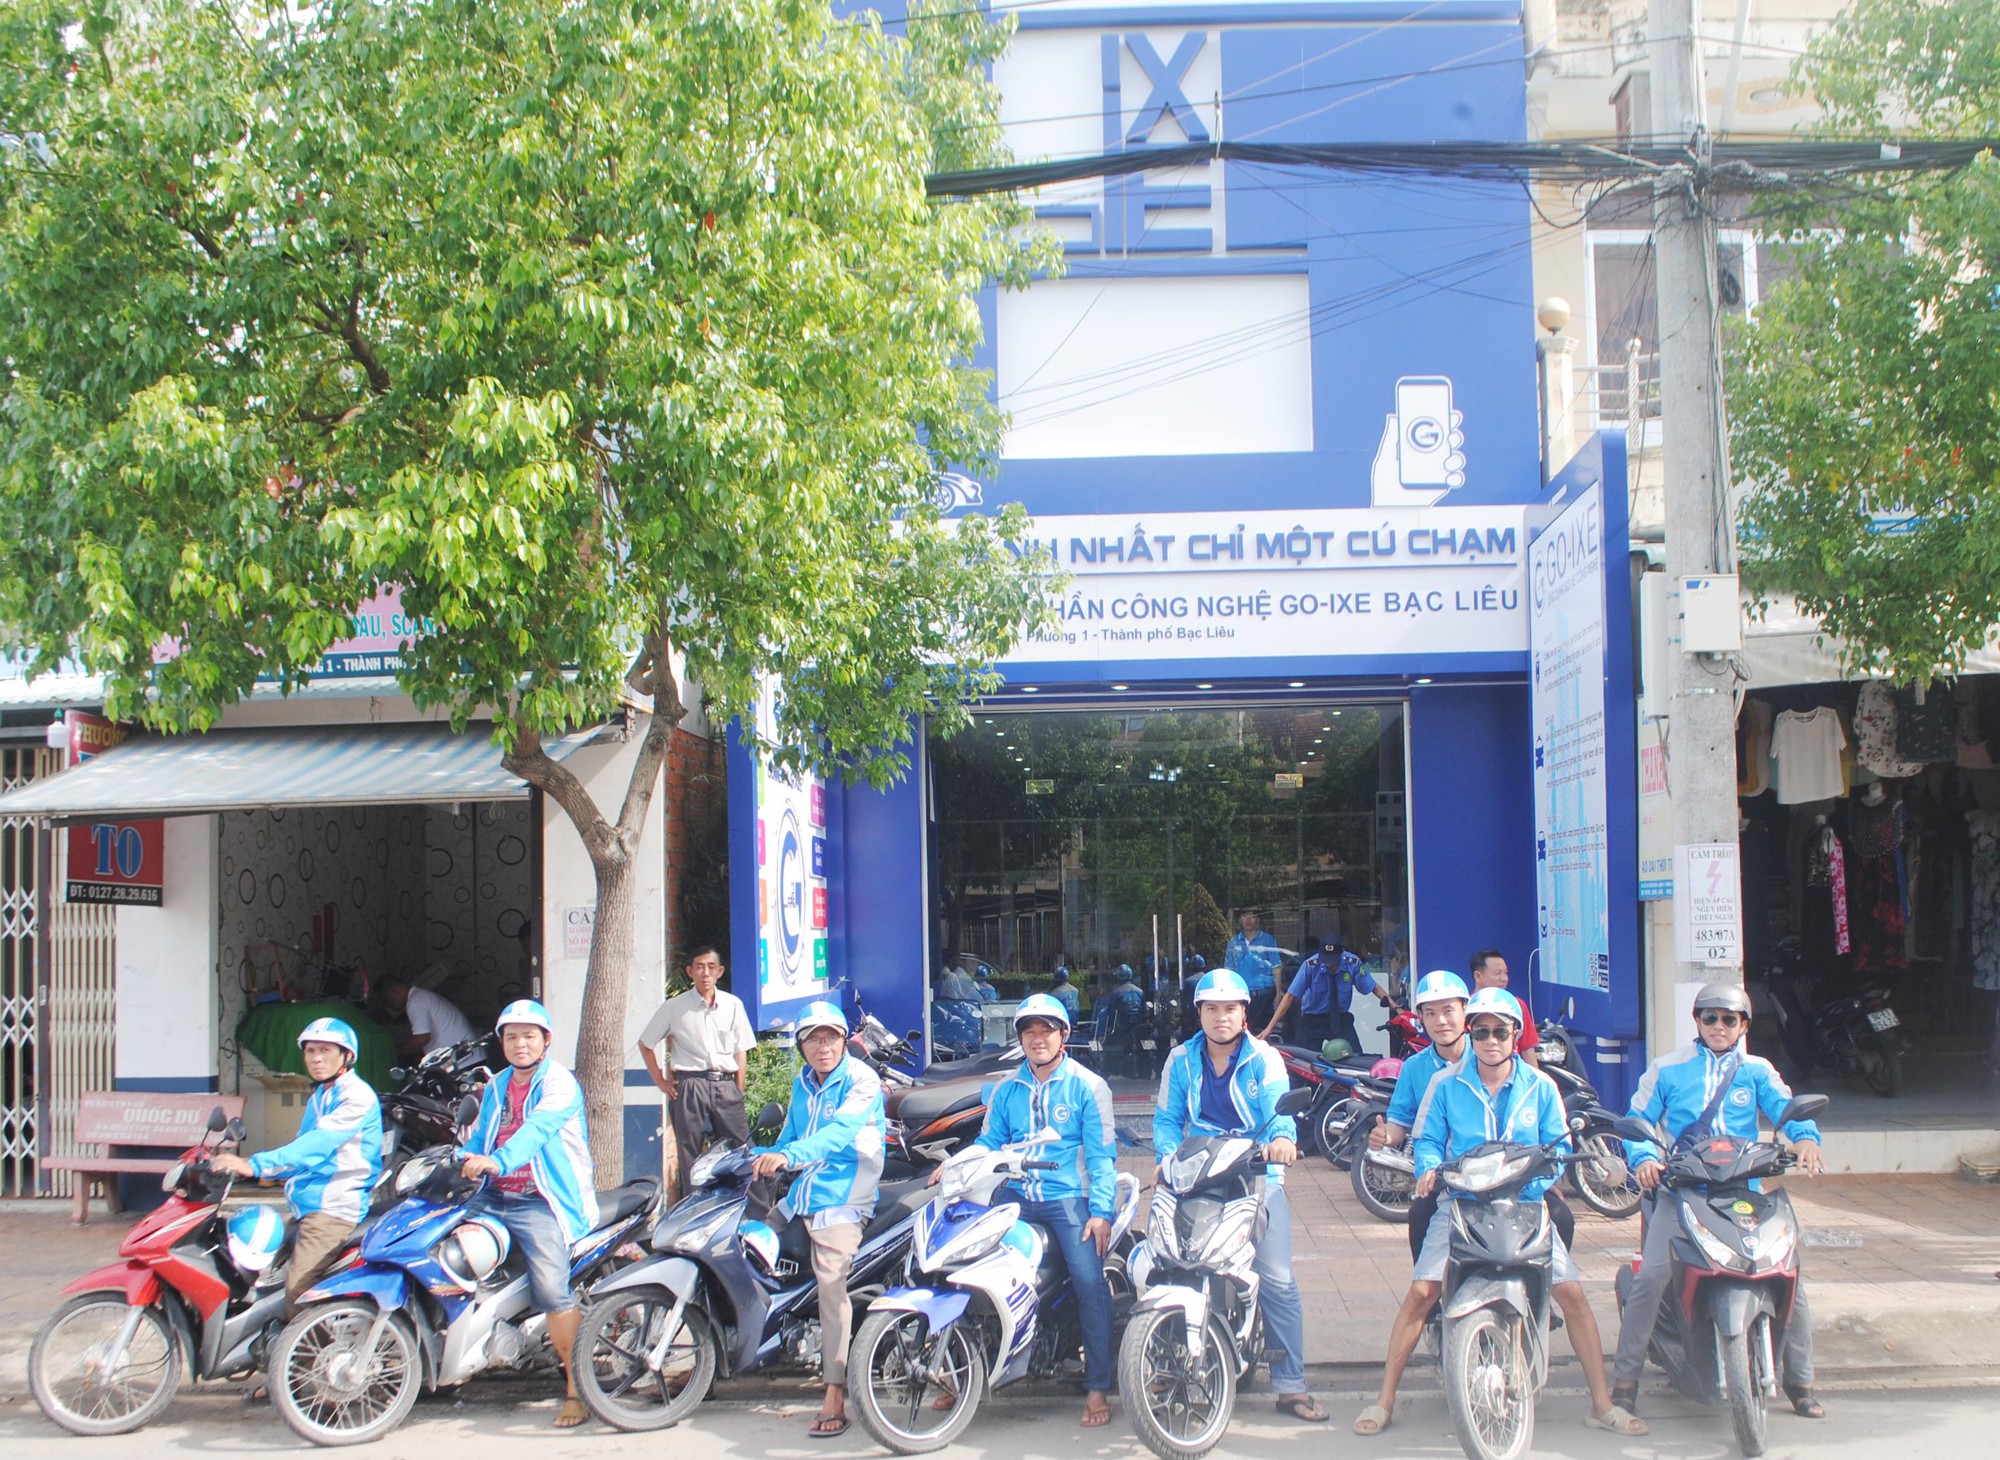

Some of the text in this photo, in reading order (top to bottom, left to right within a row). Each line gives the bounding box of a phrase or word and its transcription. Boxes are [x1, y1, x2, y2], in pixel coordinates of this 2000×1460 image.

[1071, 522, 1175, 563] NHẤT
[1188, 523, 1245, 560] CHỈ
[1256, 524, 1334, 565] MỘT
[1347, 521, 1396, 557] CÚ
[1408, 527, 1516, 561] CHẠM
[1546, 502, 1598, 586] GO-IXE
[1054, 584, 1518, 620] HẦN CÔNG NGHỆ GO-IXE BẠC LIÊU
[1082, 629, 1088, 641] 1
[1101, 628, 1142, 641] Thành
[1147, 625, 1173, 643] phố
[1177, 627, 1202, 642] Bạc
[1206, 626, 1235, 638] Liêu
[343, 655, 381, 672] THÀNH
[91, 823, 143, 879] TO
[1708, 946, 1727, 960] 02
